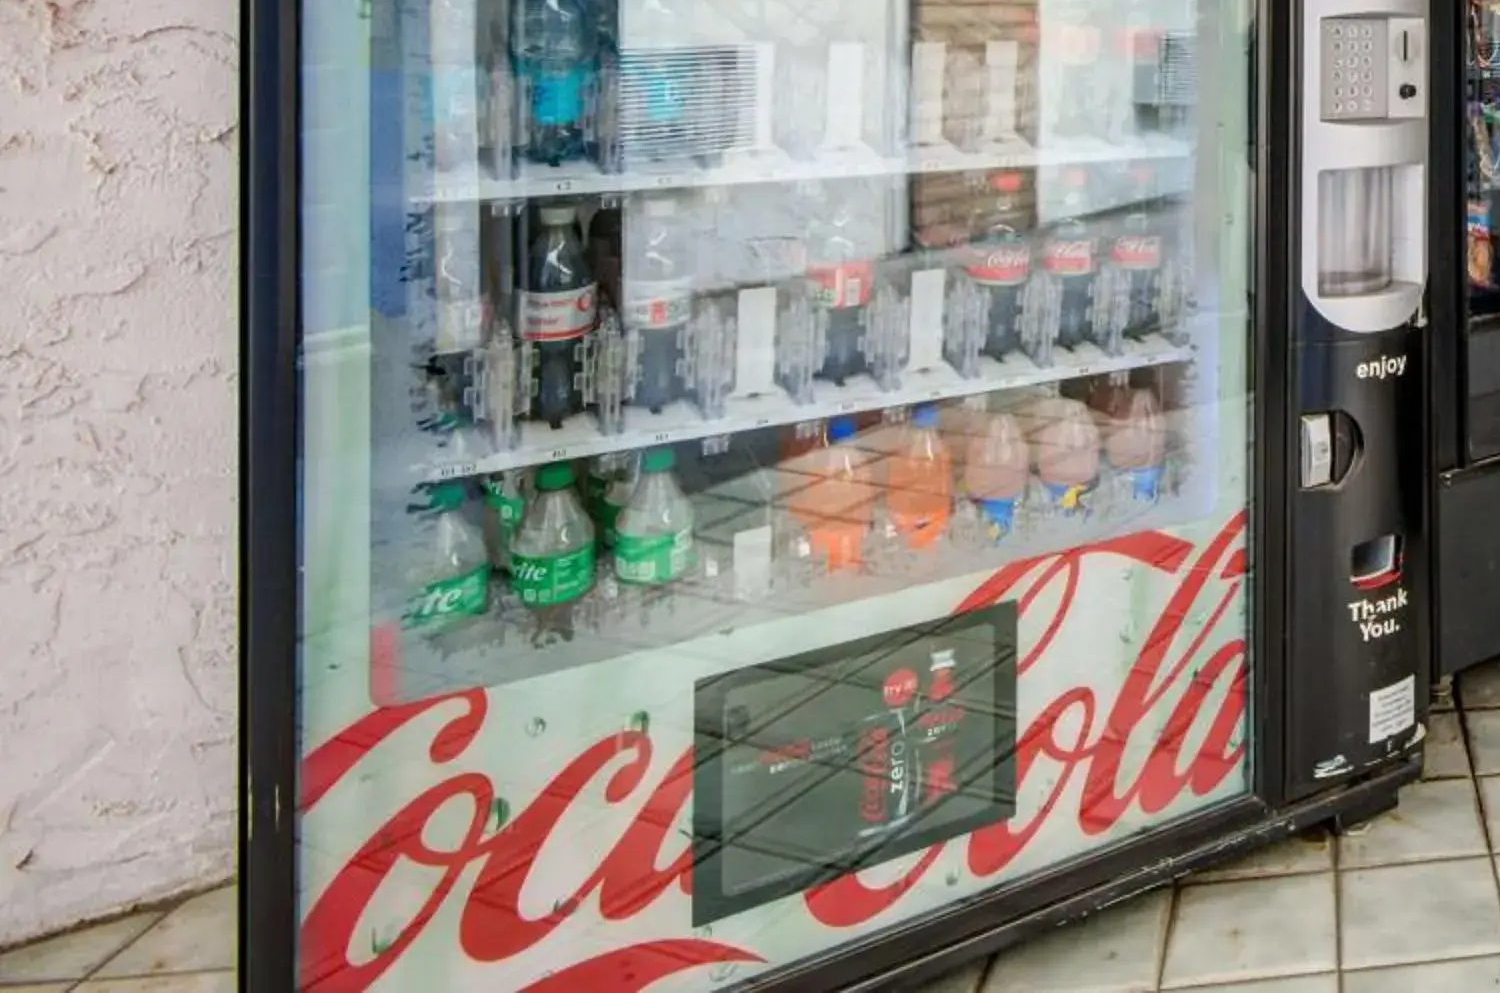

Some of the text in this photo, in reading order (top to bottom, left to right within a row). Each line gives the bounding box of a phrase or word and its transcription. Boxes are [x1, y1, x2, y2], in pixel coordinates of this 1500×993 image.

[1357, 354, 1407, 379] enjoy
[1347, 588, 1408, 622] Thank
[1360, 615, 1401, 642] You.
[890, 740, 905, 794] zero
